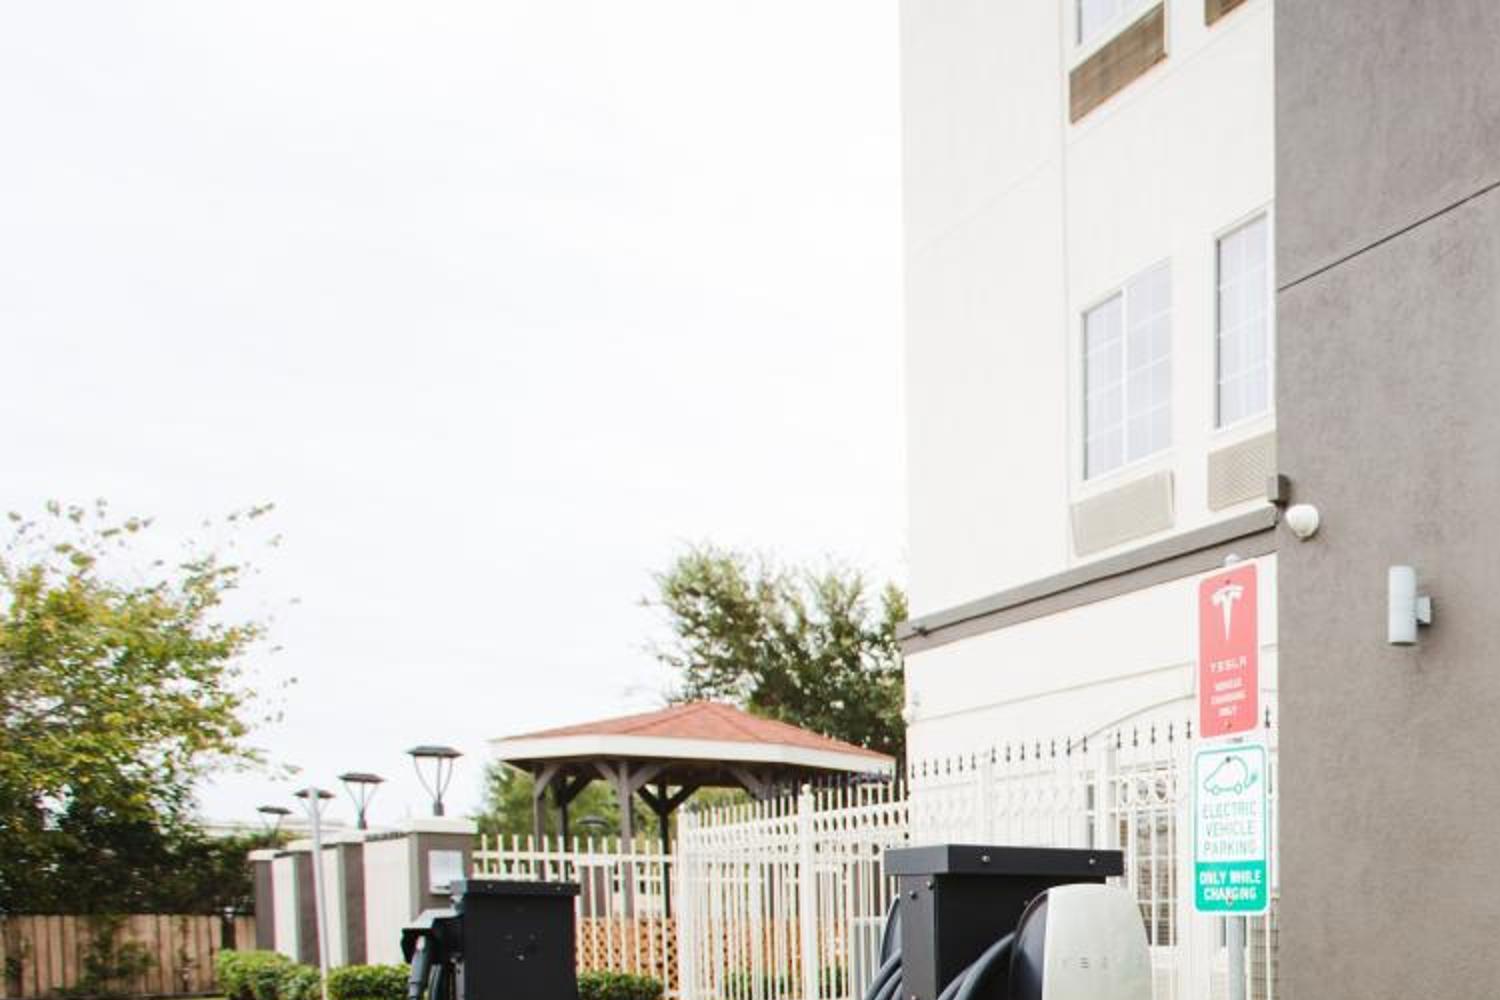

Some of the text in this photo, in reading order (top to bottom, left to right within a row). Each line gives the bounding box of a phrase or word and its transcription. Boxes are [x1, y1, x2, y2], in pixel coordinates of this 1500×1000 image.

[1203, 801, 1256, 819] ELECTRIC
[1206, 820, 1254, 836] VEHICLE
[1203, 839, 1257, 856] PARKING
[1200, 869, 1261, 885] ONLY WHILE
